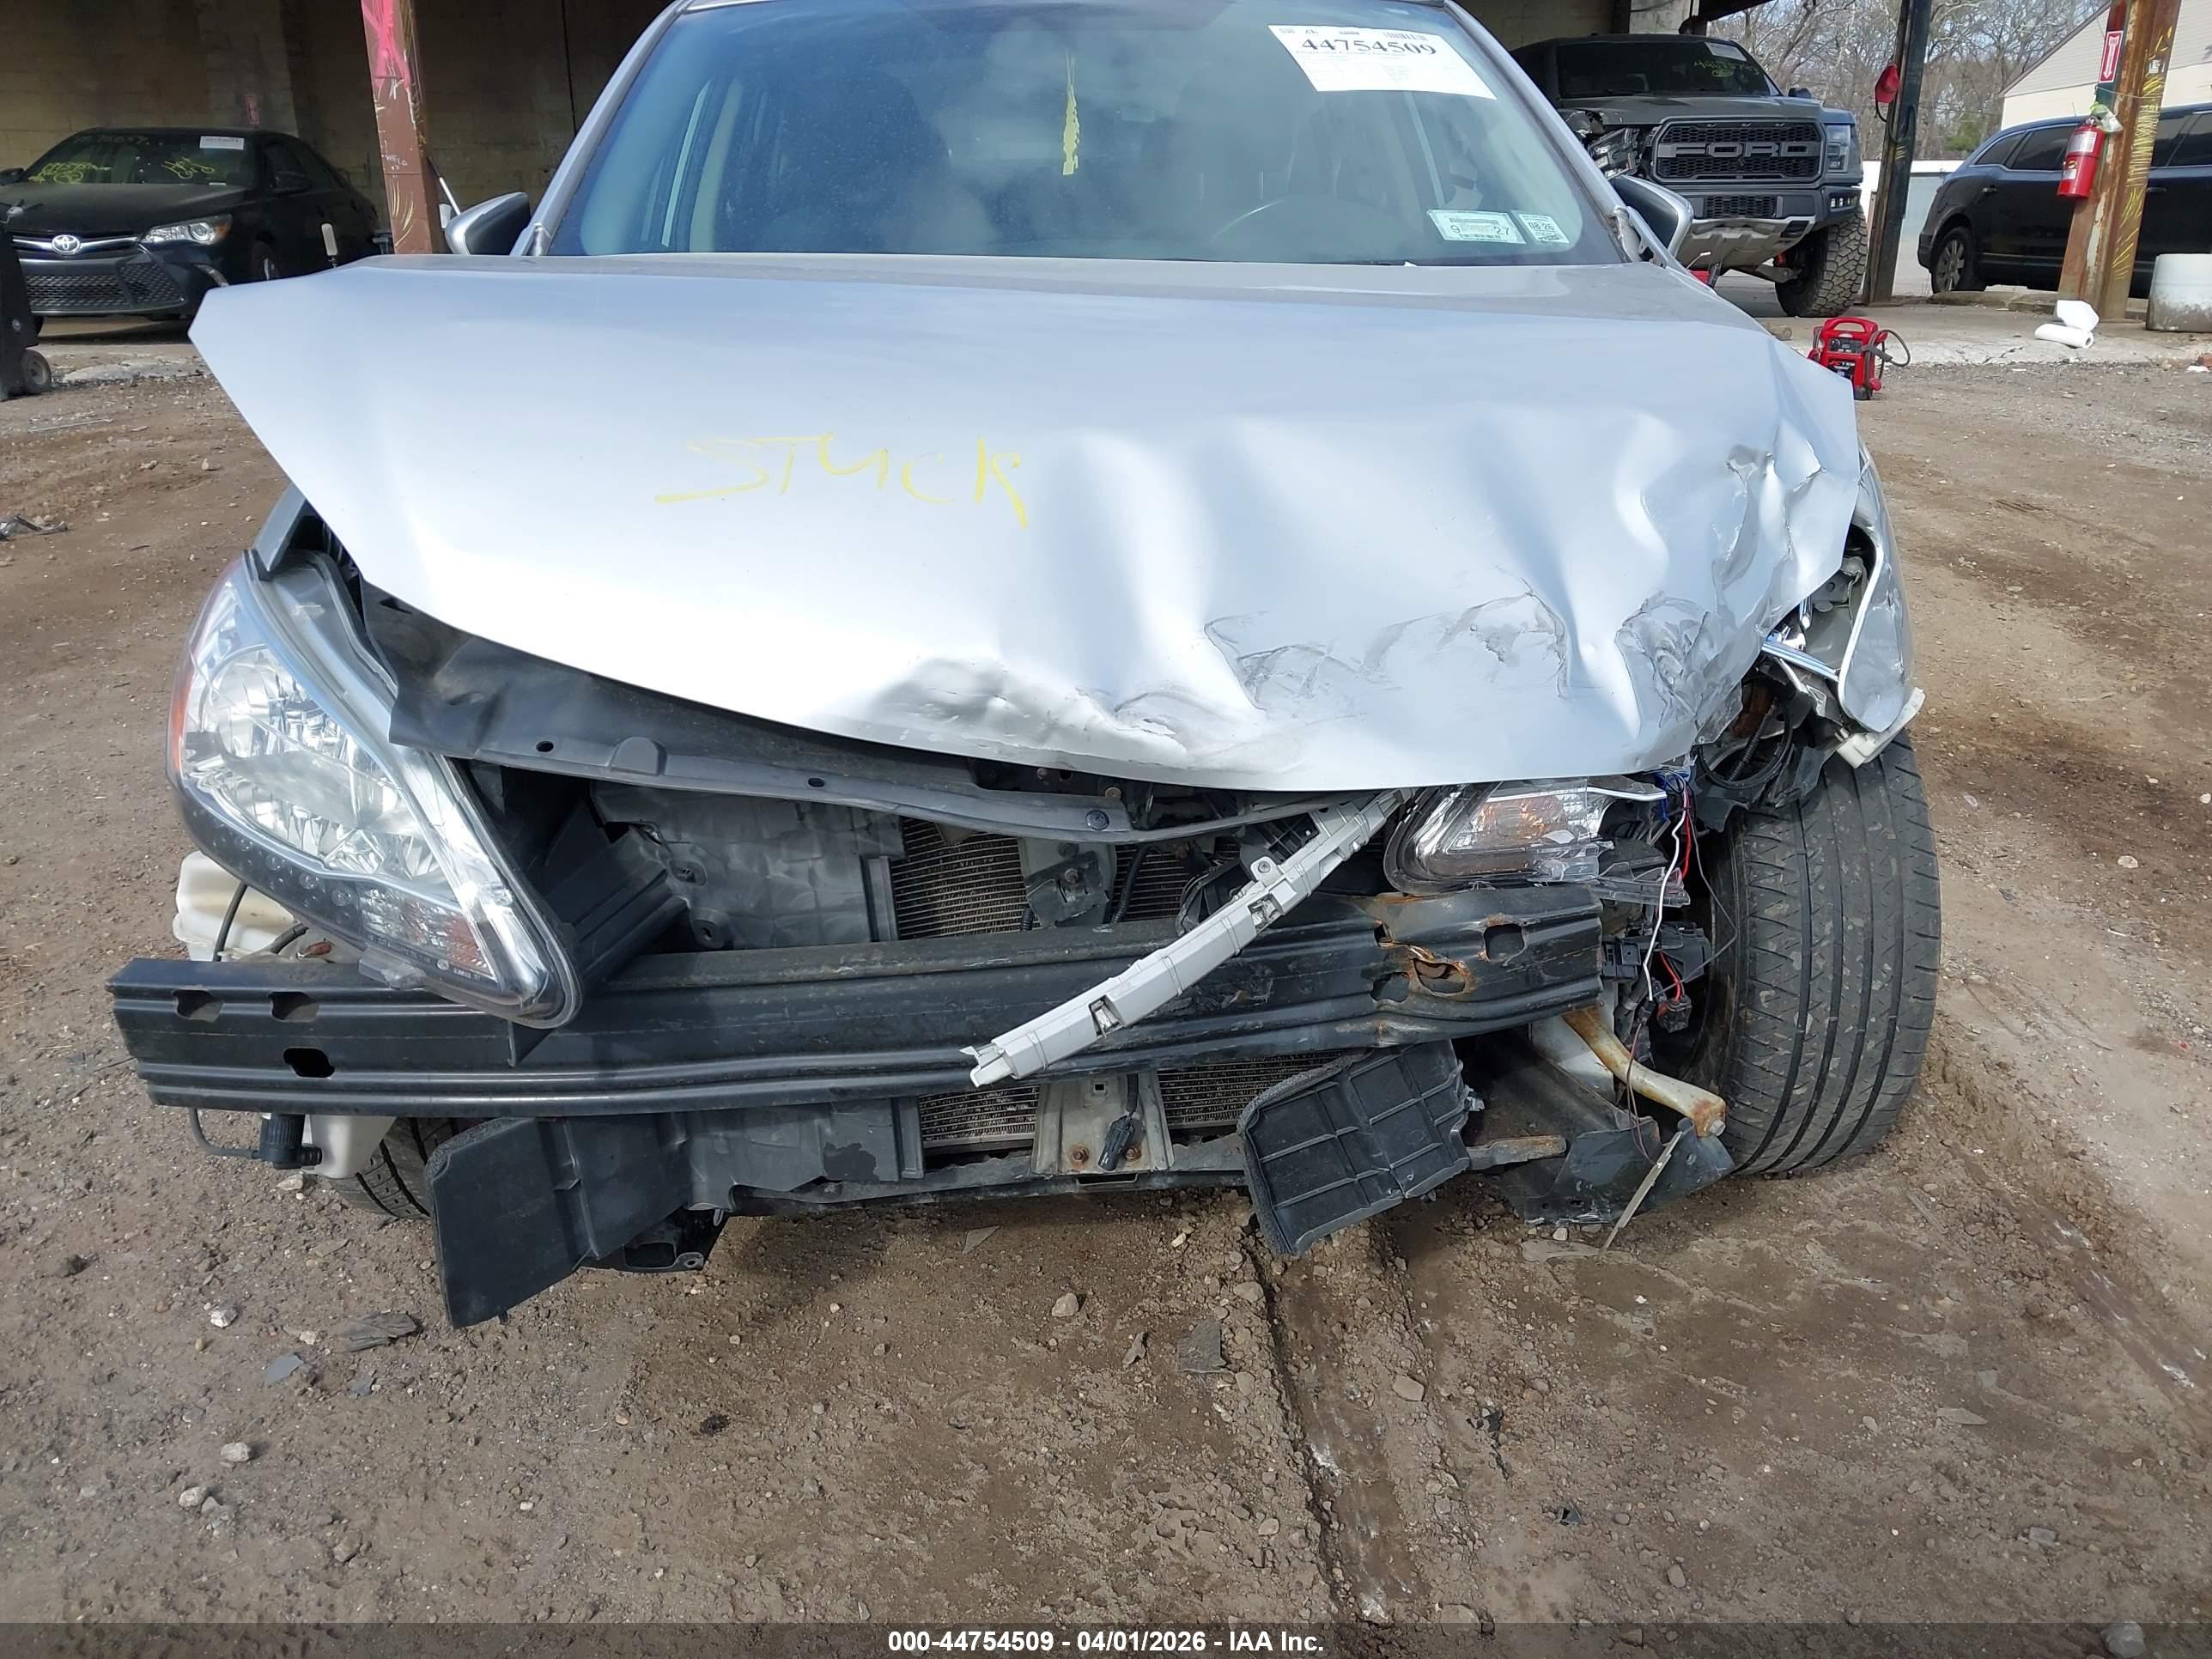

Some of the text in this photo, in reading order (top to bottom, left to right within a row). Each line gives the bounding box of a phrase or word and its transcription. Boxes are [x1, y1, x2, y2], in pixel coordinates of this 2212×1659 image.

[1302, 39, 1437, 55] 44754509
[1658, 141, 1821, 158] FORD
[1494, 227, 1509, 235] 27
[654, 431, 1029, 529] STUCK
